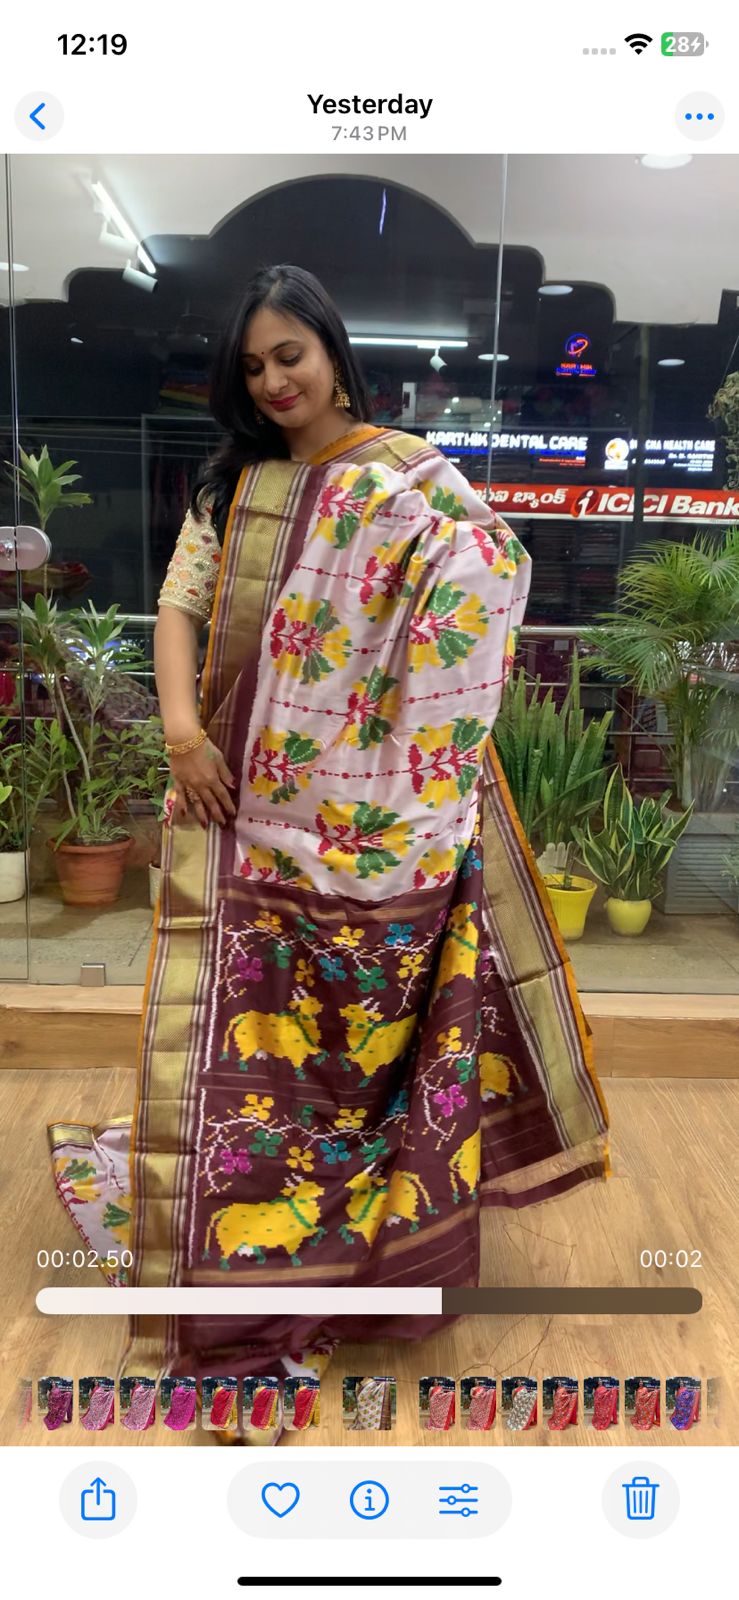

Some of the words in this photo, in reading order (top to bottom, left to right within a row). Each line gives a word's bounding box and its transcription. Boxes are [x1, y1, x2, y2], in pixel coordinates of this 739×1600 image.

[426, 431, 488, 447] KARTHIK
[491, 433, 548, 449] DENTAL
[549, 435, 588, 451] CARE
[663, 440, 694, 451] HEALTH
[695, 440, 716, 452] CARE
[597, 493, 669, 514] ICICI
